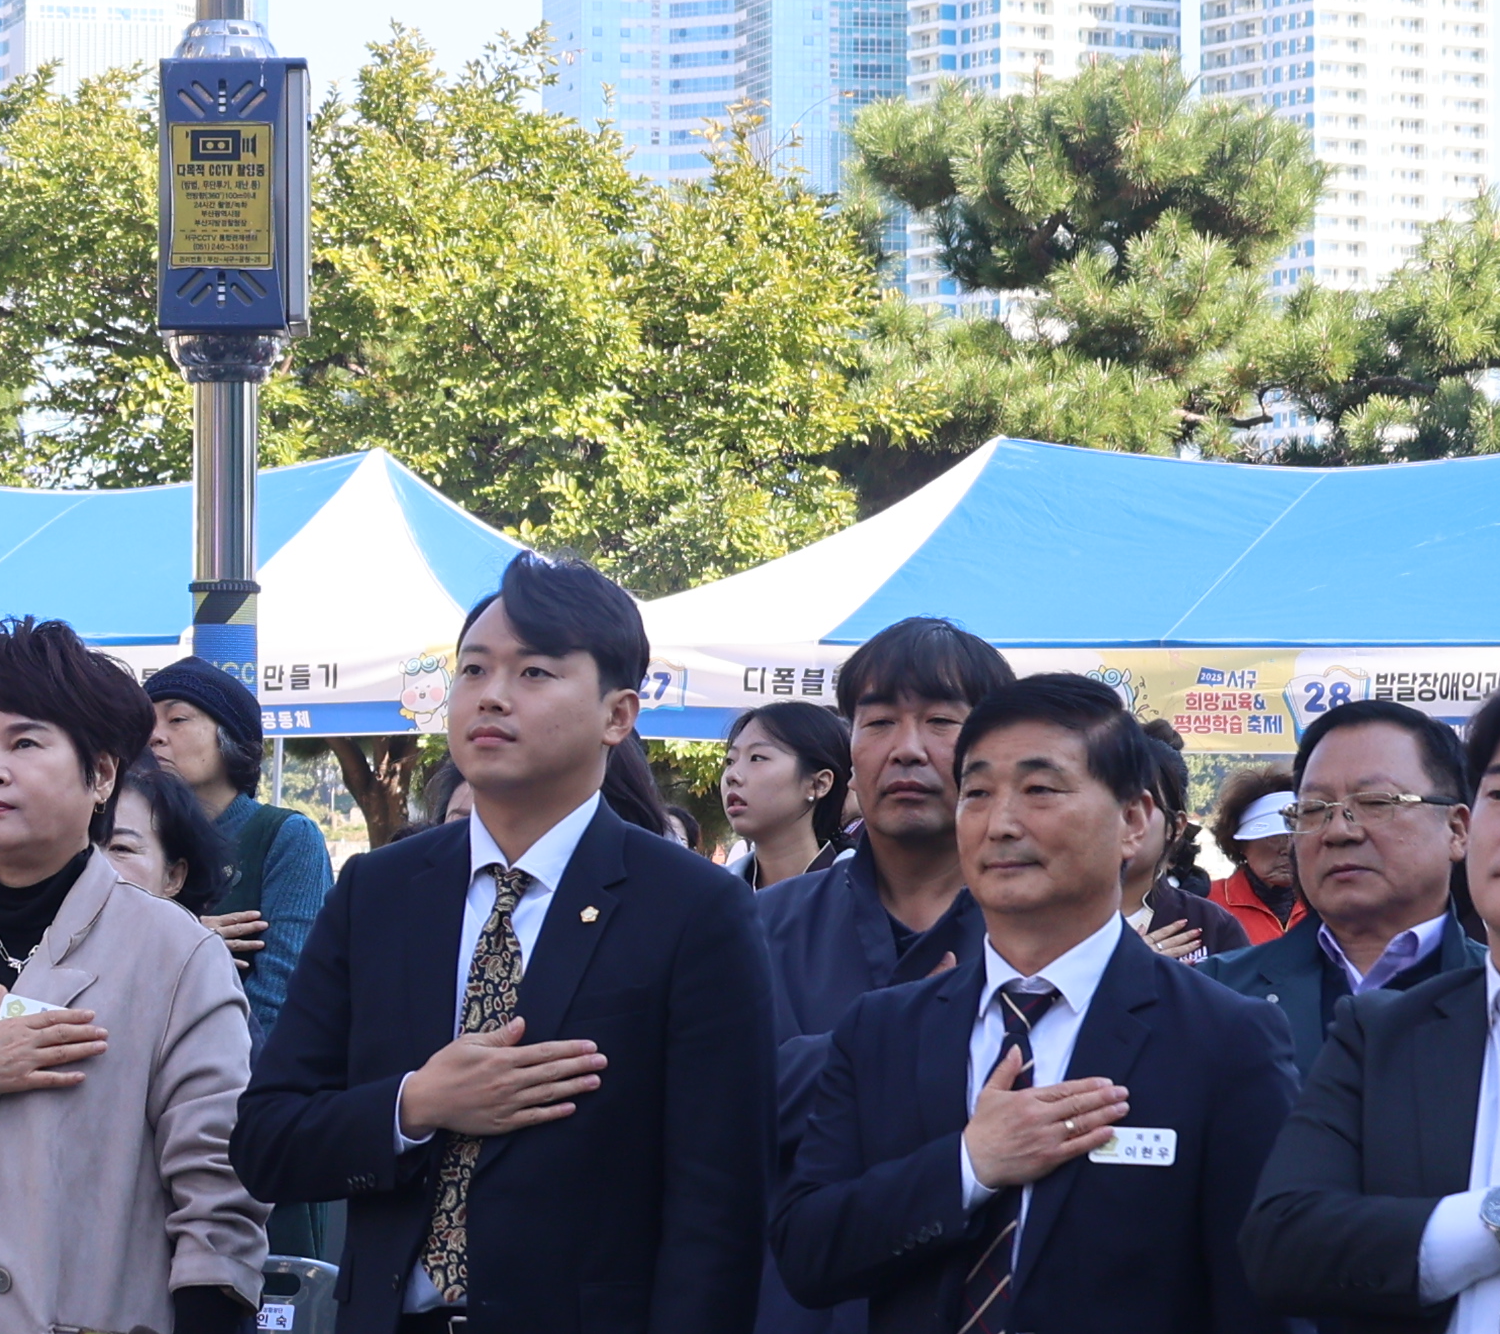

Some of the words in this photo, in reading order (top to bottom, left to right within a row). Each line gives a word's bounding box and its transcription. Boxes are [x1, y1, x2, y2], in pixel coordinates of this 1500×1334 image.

[177, 164, 204, 177] 다목적
[209, 164, 233, 177] CCTV
[237, 164, 265, 177] 촬영중
[263, 662, 338, 692] 만들기
[1200, 672, 1222, 681] 2025
[1226, 670, 1257, 689] 서구
[1185, 692, 1266, 712] 희망교육&
[1304, 681, 1351, 713] 28
[1174, 714, 1242, 735] 평생학습
[1247, 715, 1282, 734] 축제
